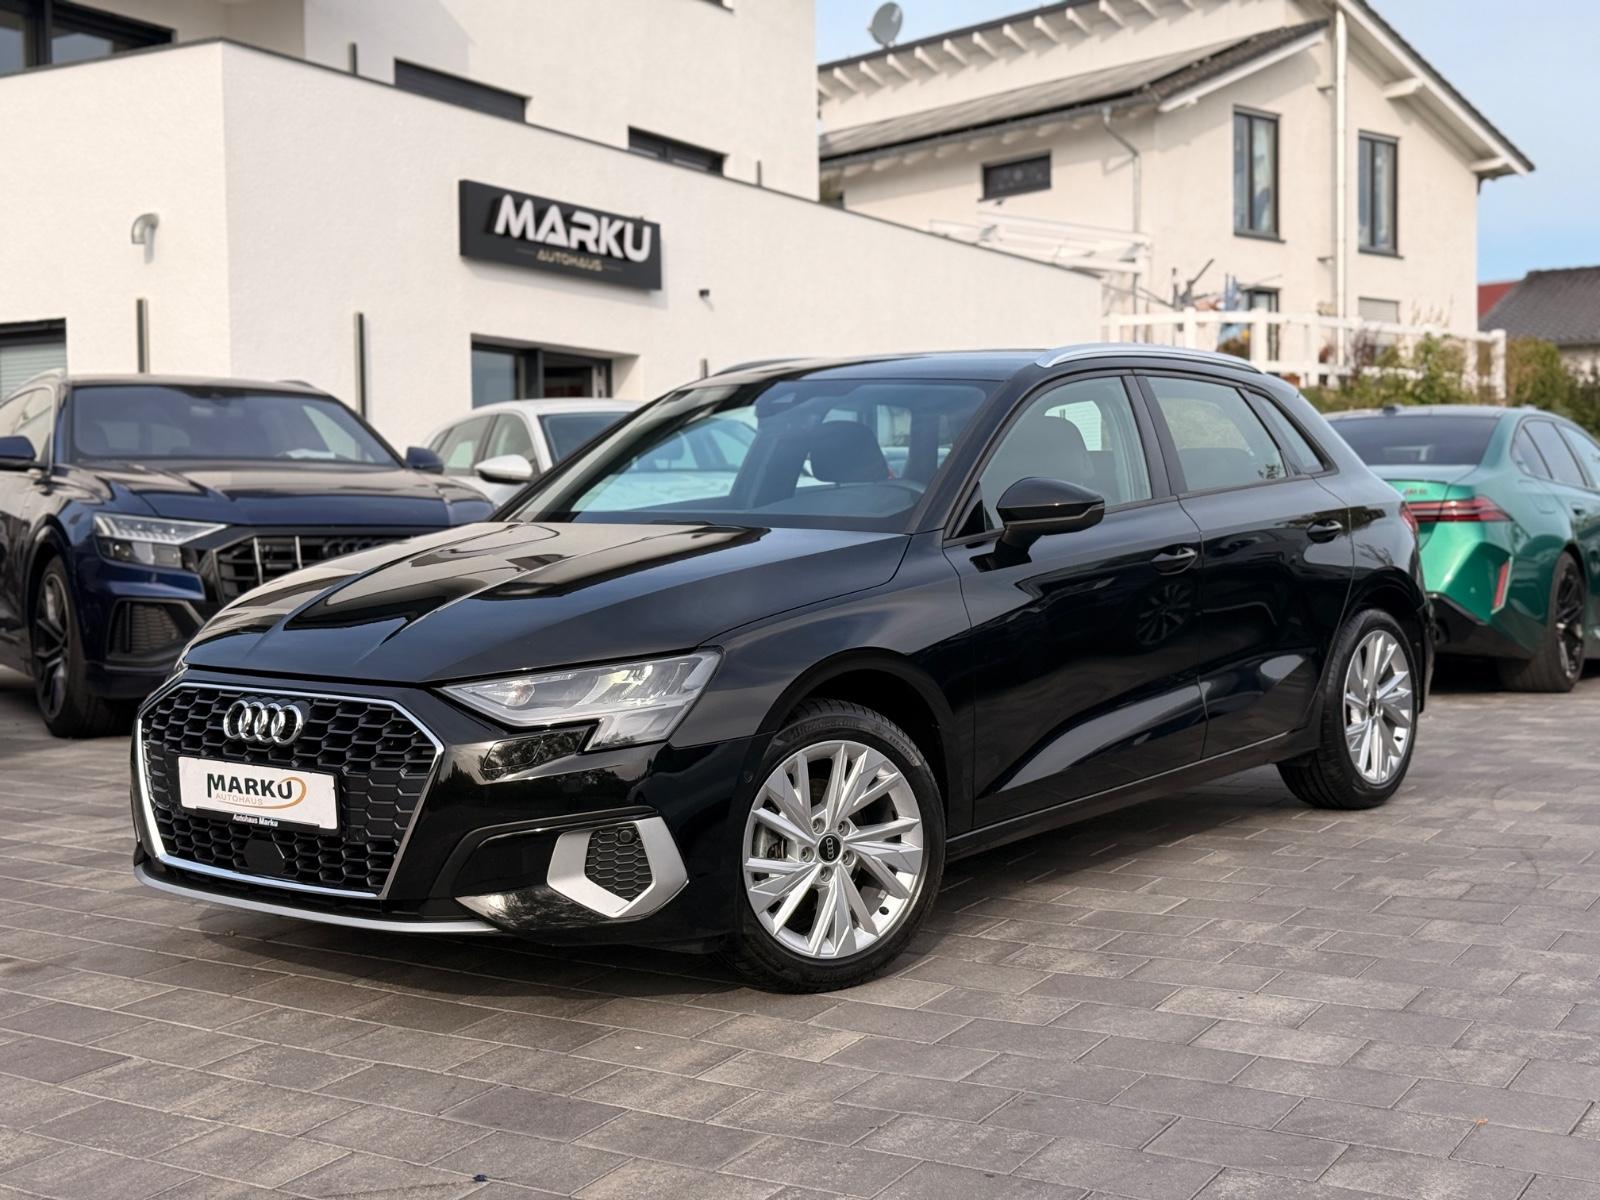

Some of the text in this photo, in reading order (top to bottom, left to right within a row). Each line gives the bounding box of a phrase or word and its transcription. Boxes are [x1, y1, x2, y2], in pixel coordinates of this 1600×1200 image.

[495, 194, 652, 262] MARKU
[536, 250, 603, 271] AUTOHAUS
[207, 773, 293, 799] MARKU
[215, 792, 263, 805] AUTOHAUS
[233, 813, 278, 827] Autohaus Marku
